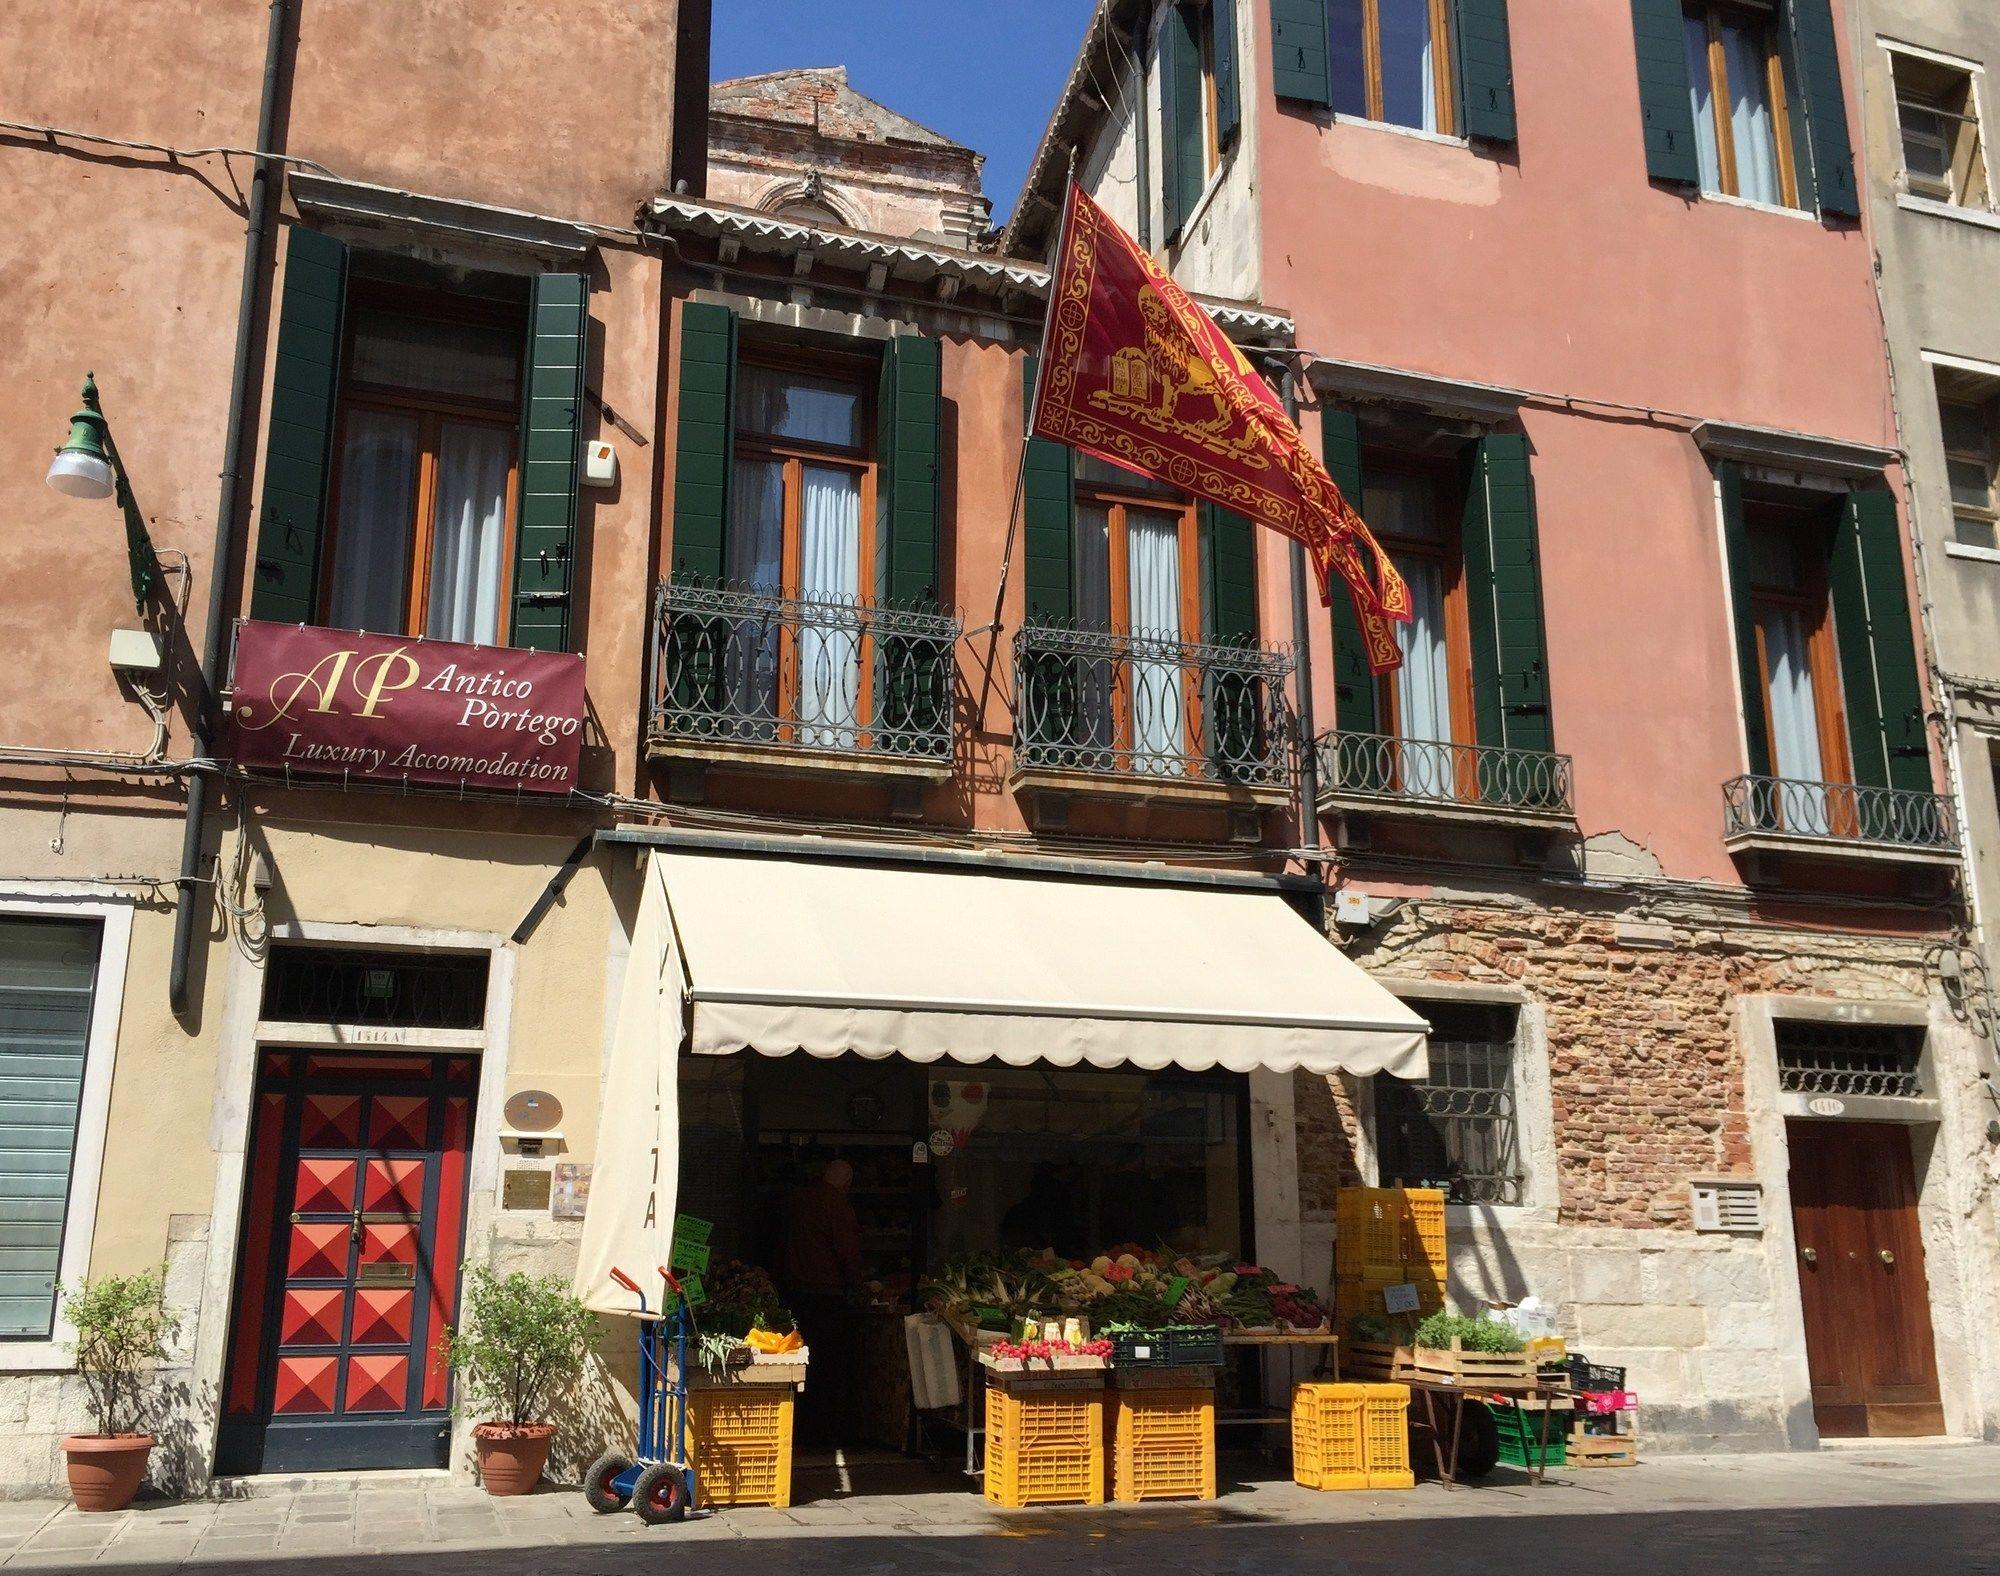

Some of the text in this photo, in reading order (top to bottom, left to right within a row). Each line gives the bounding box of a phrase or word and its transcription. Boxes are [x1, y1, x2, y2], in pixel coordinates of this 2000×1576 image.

[236, 646, 420, 731] AP
[422, 664, 533, 699] Antico
[457, 699, 580, 746] Pòrtego
[283, 733, 387, 773] Luxury
[389, 743, 568, 781] Accomodation
